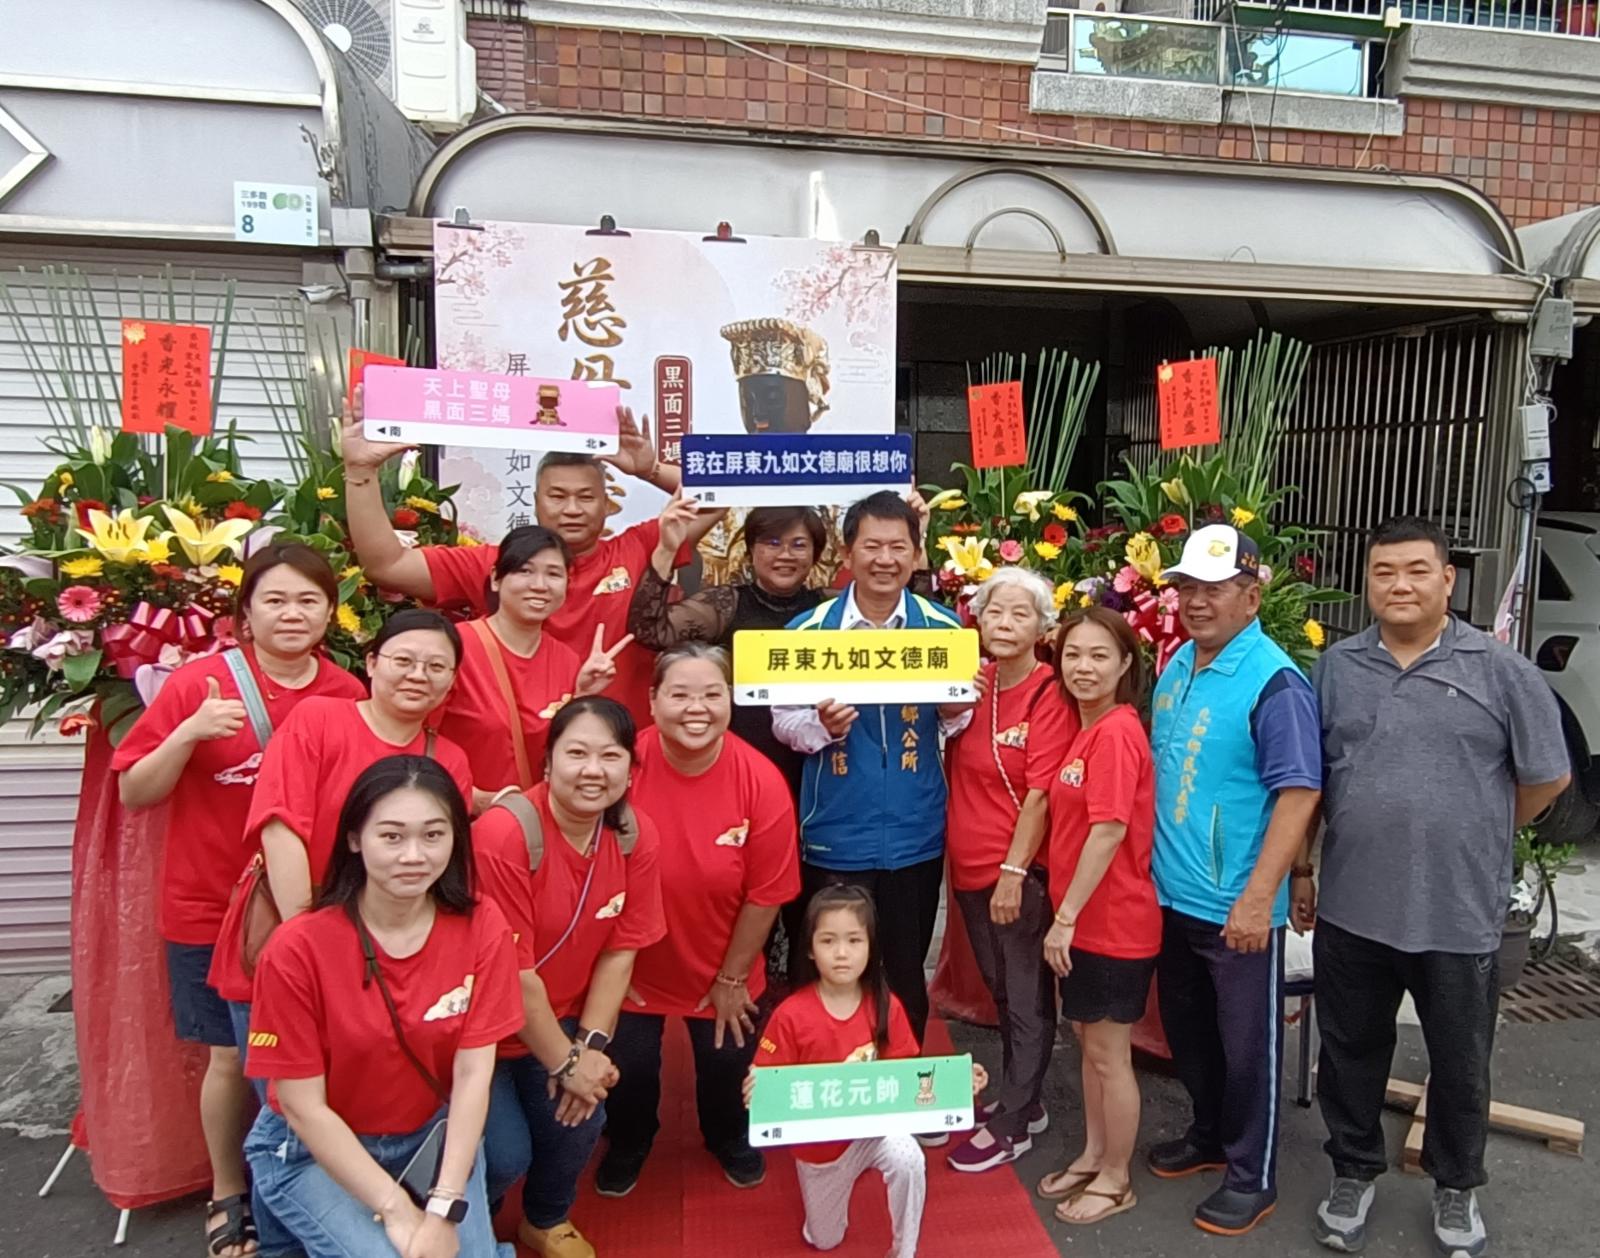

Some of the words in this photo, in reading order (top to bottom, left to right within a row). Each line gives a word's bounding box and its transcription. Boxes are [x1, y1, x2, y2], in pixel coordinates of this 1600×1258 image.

[242, 214, 254, 233] 8
[423, 377, 511, 401] 天上聖母
[423, 400, 511, 425] 黑面三媽
[661, 366, 684, 464] 黑面三媽
[389, 426, 401, 437] 南
[586, 438, 597, 449] 北
[686, 449, 907, 475] 我在屏東九如文德廟很想你
[704, 491, 716, 502] 南
[767, 646, 949, 671] 屏東九如文德廟
[758, 688, 769, 699] 南
[948, 686, 958, 697] 北
[832, 741, 848, 775] 信
[789, 1076, 899, 1110] 蓮花元帥
[945, 1114, 954, 1125] 北
[772, 1127, 782, 1139] 南
